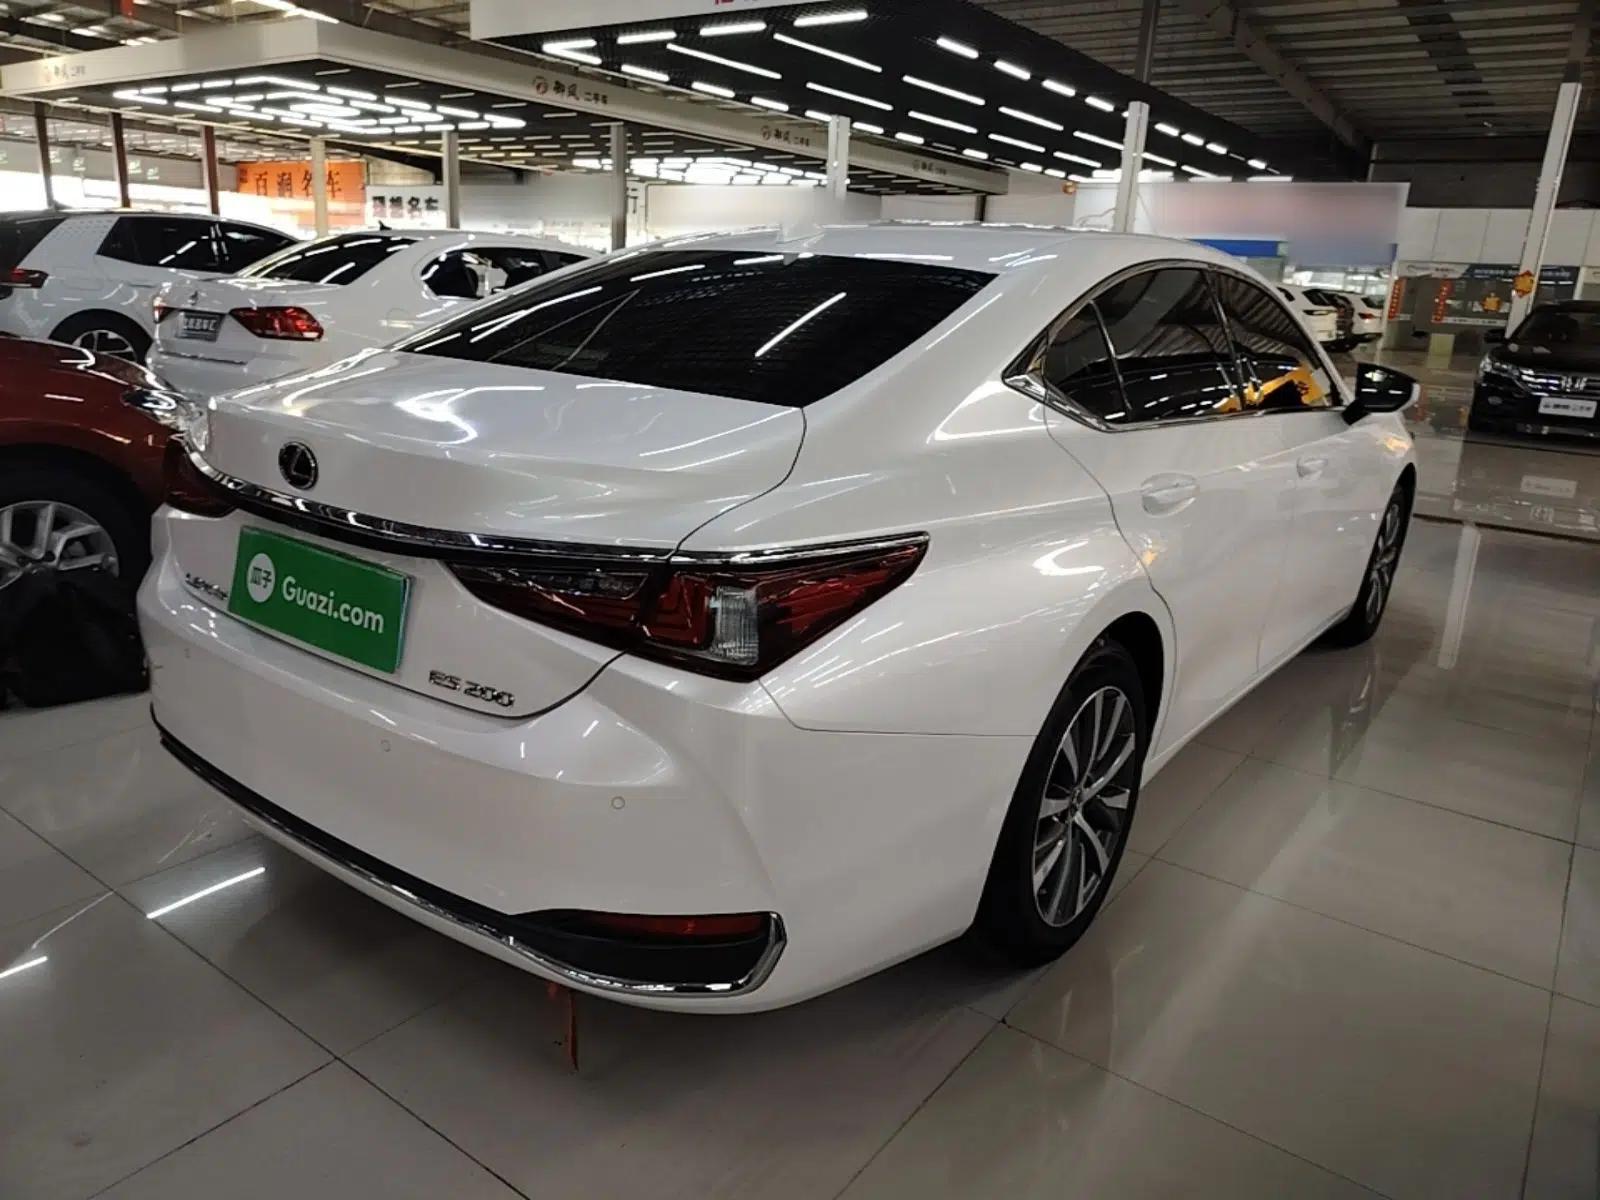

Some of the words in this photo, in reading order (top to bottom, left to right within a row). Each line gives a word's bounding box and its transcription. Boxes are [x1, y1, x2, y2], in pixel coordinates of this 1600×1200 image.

[250, 565, 273, 588] 瓜子
[282, 575, 385, 634] Guazi.com
[463, 680, 514, 708] 200
